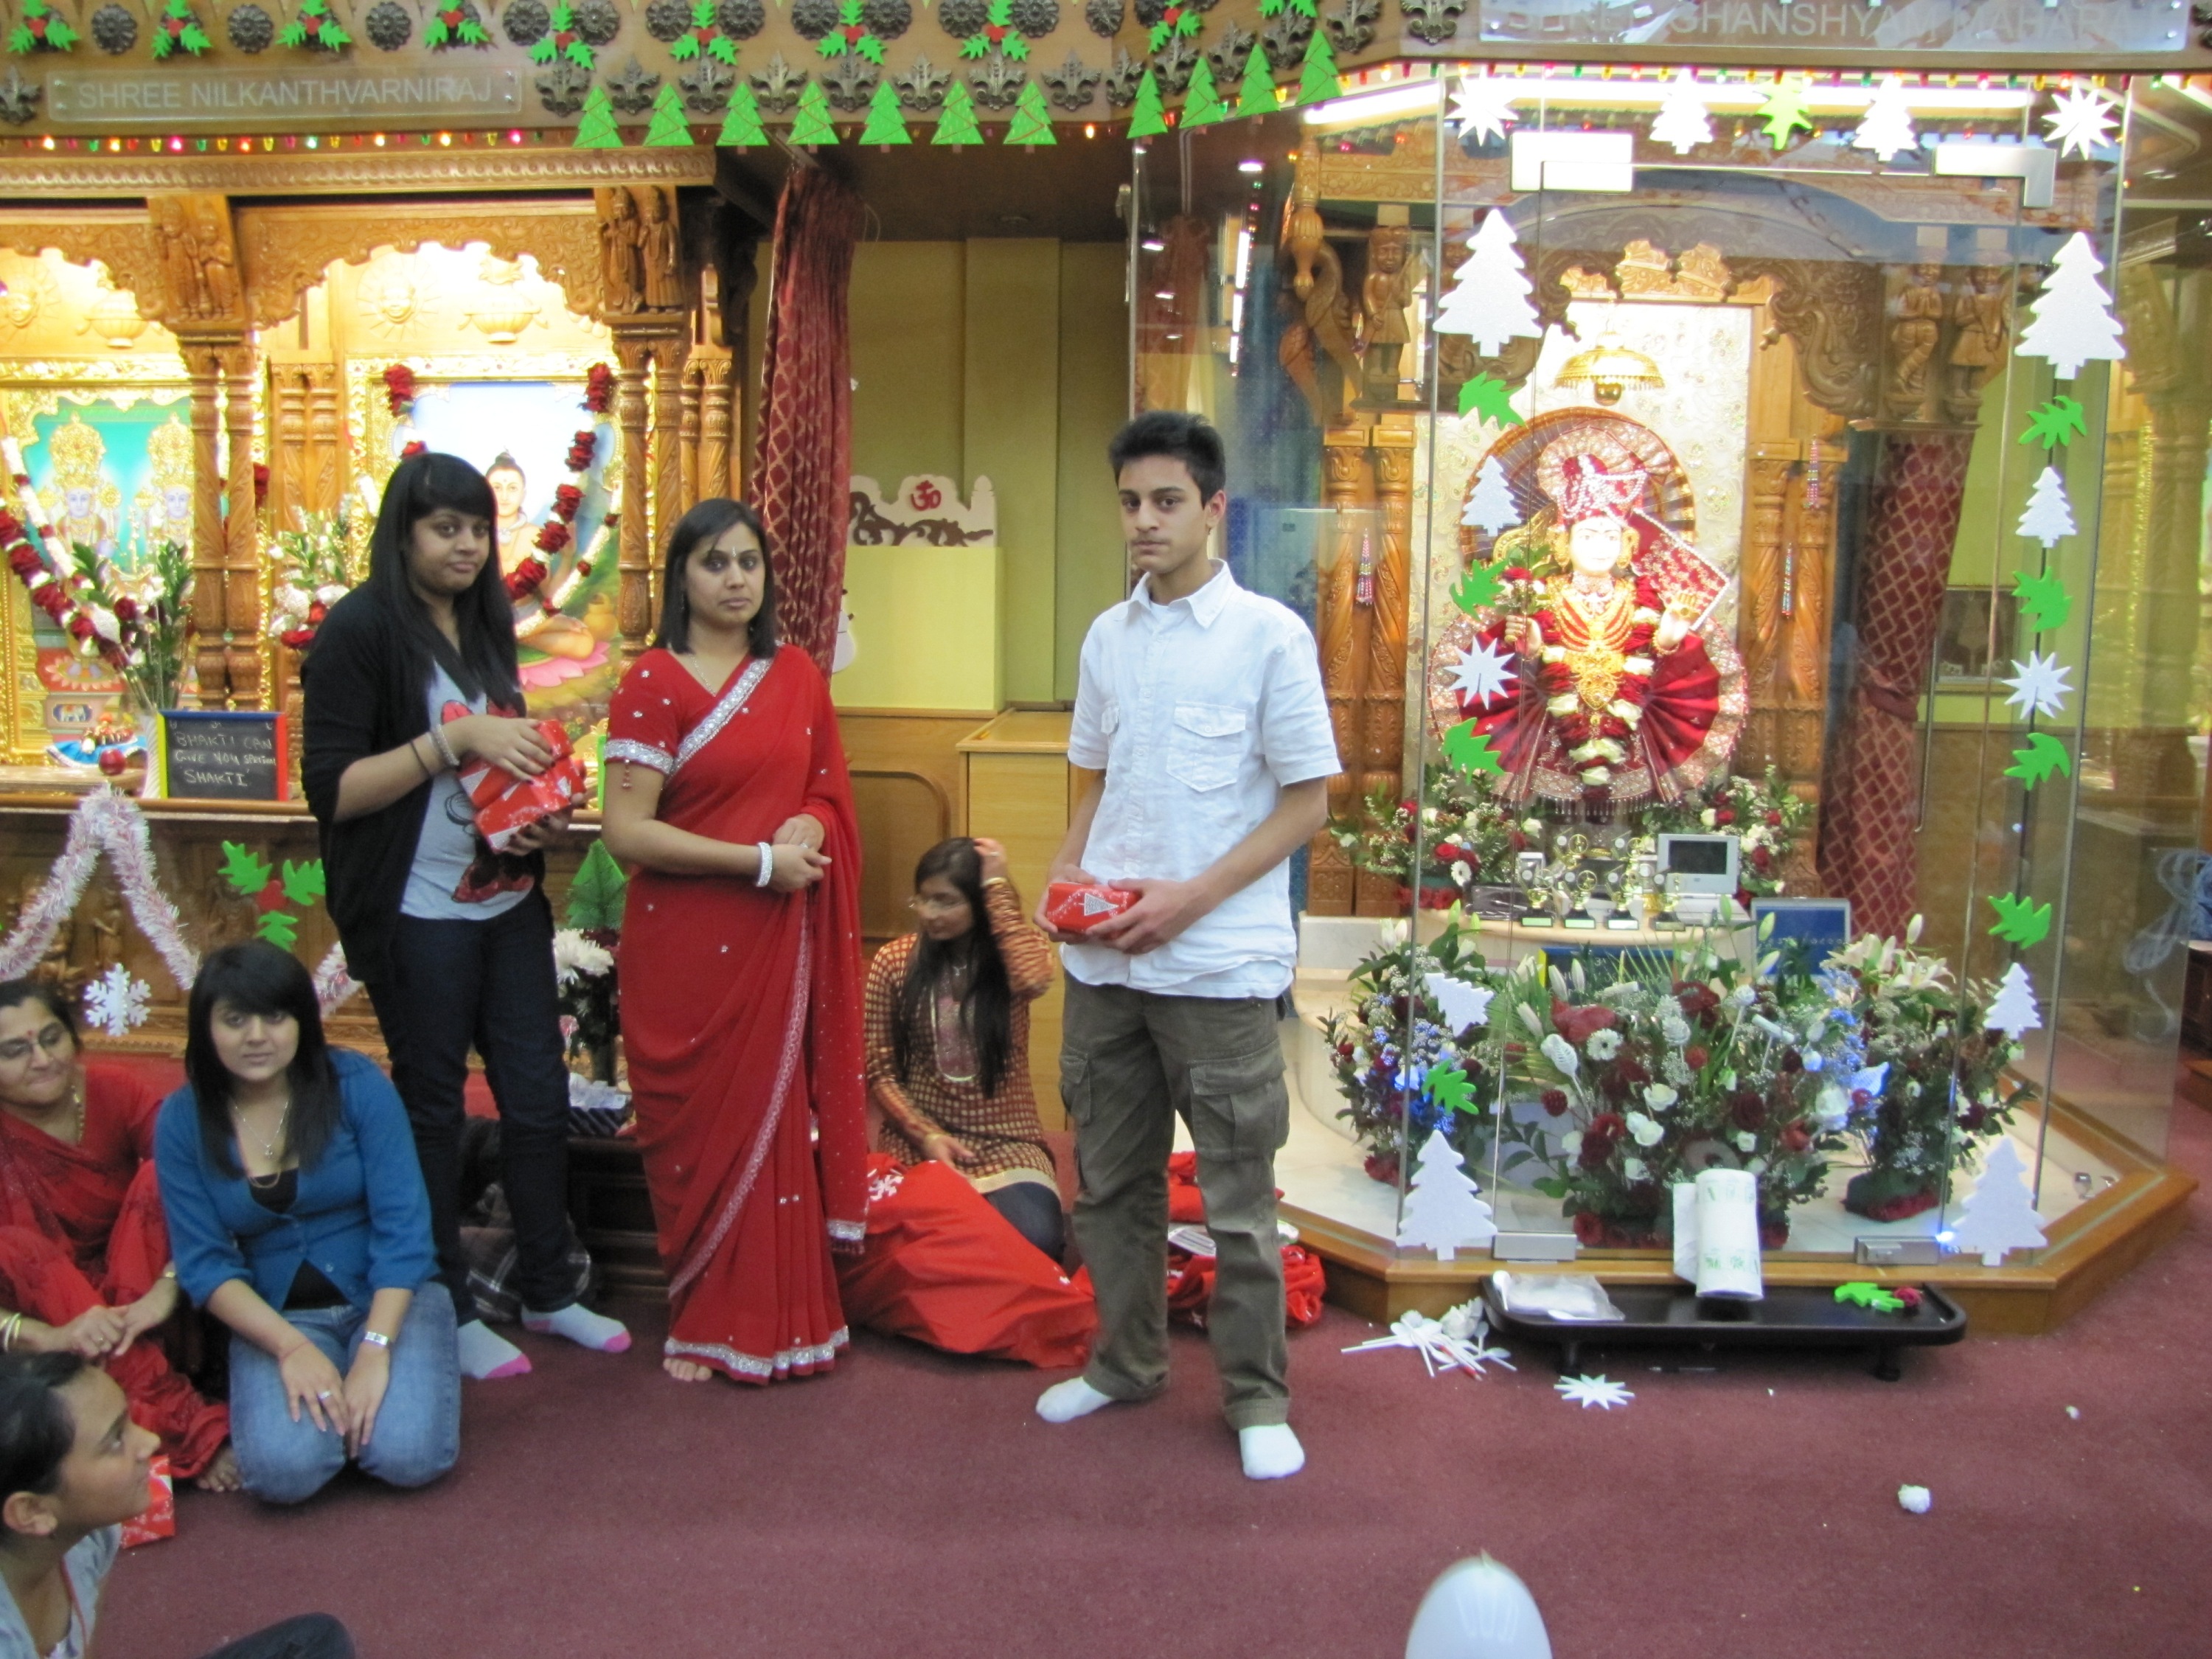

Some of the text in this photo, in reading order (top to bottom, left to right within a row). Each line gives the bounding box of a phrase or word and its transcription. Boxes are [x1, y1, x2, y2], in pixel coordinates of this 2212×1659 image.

[1669, 2, 1937, 38] GHANSHYAM
[1952, 3, 2158, 38] MAHARA
[78, 77, 492, 108] SHREE NILKANTHVARNIRAJ
[175, 731, 272, 750] BHAKTI CAN
[214, 751, 240, 765] YOU
